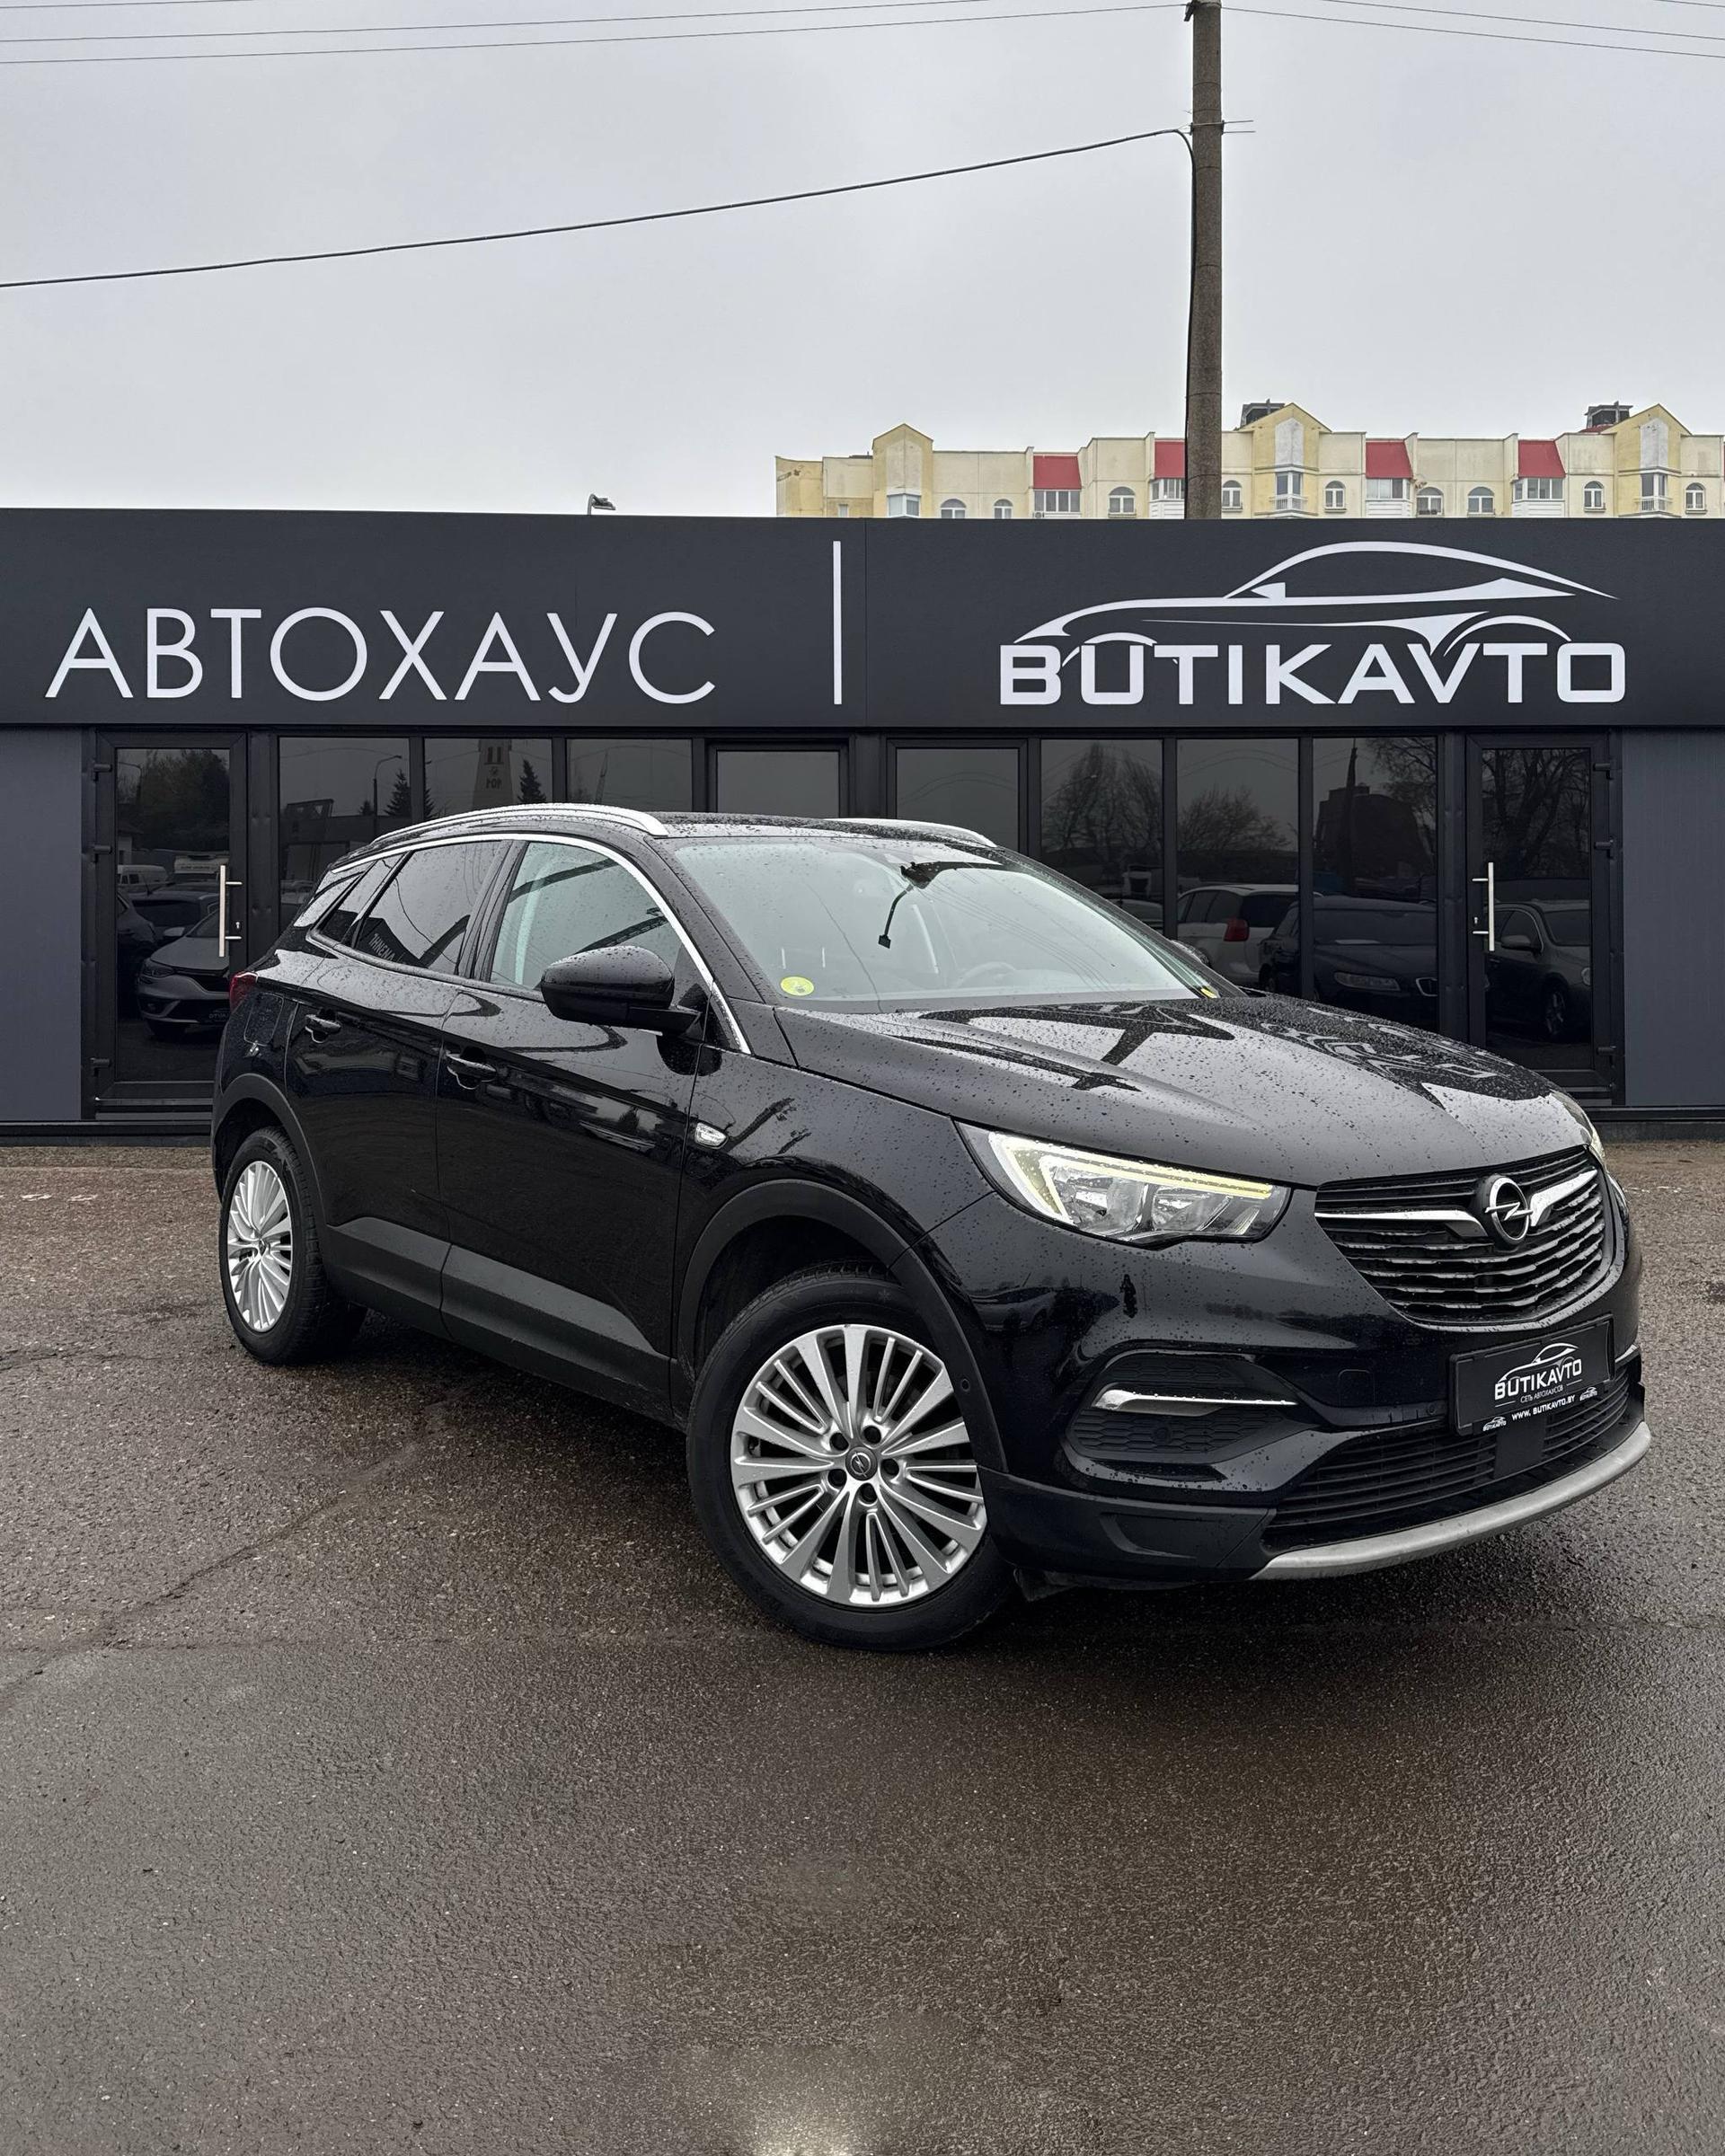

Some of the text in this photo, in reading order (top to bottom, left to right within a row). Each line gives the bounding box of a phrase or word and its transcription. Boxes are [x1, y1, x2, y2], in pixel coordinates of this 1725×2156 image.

[45, 606, 716, 704] АВТОХАУС
[999, 642, 1626, 705] BUTIKAVTO
[1494, 1358, 1581, 1401] BUTIKAVTO
[1520, 1394, 1534, 1403] СЕТЬ
